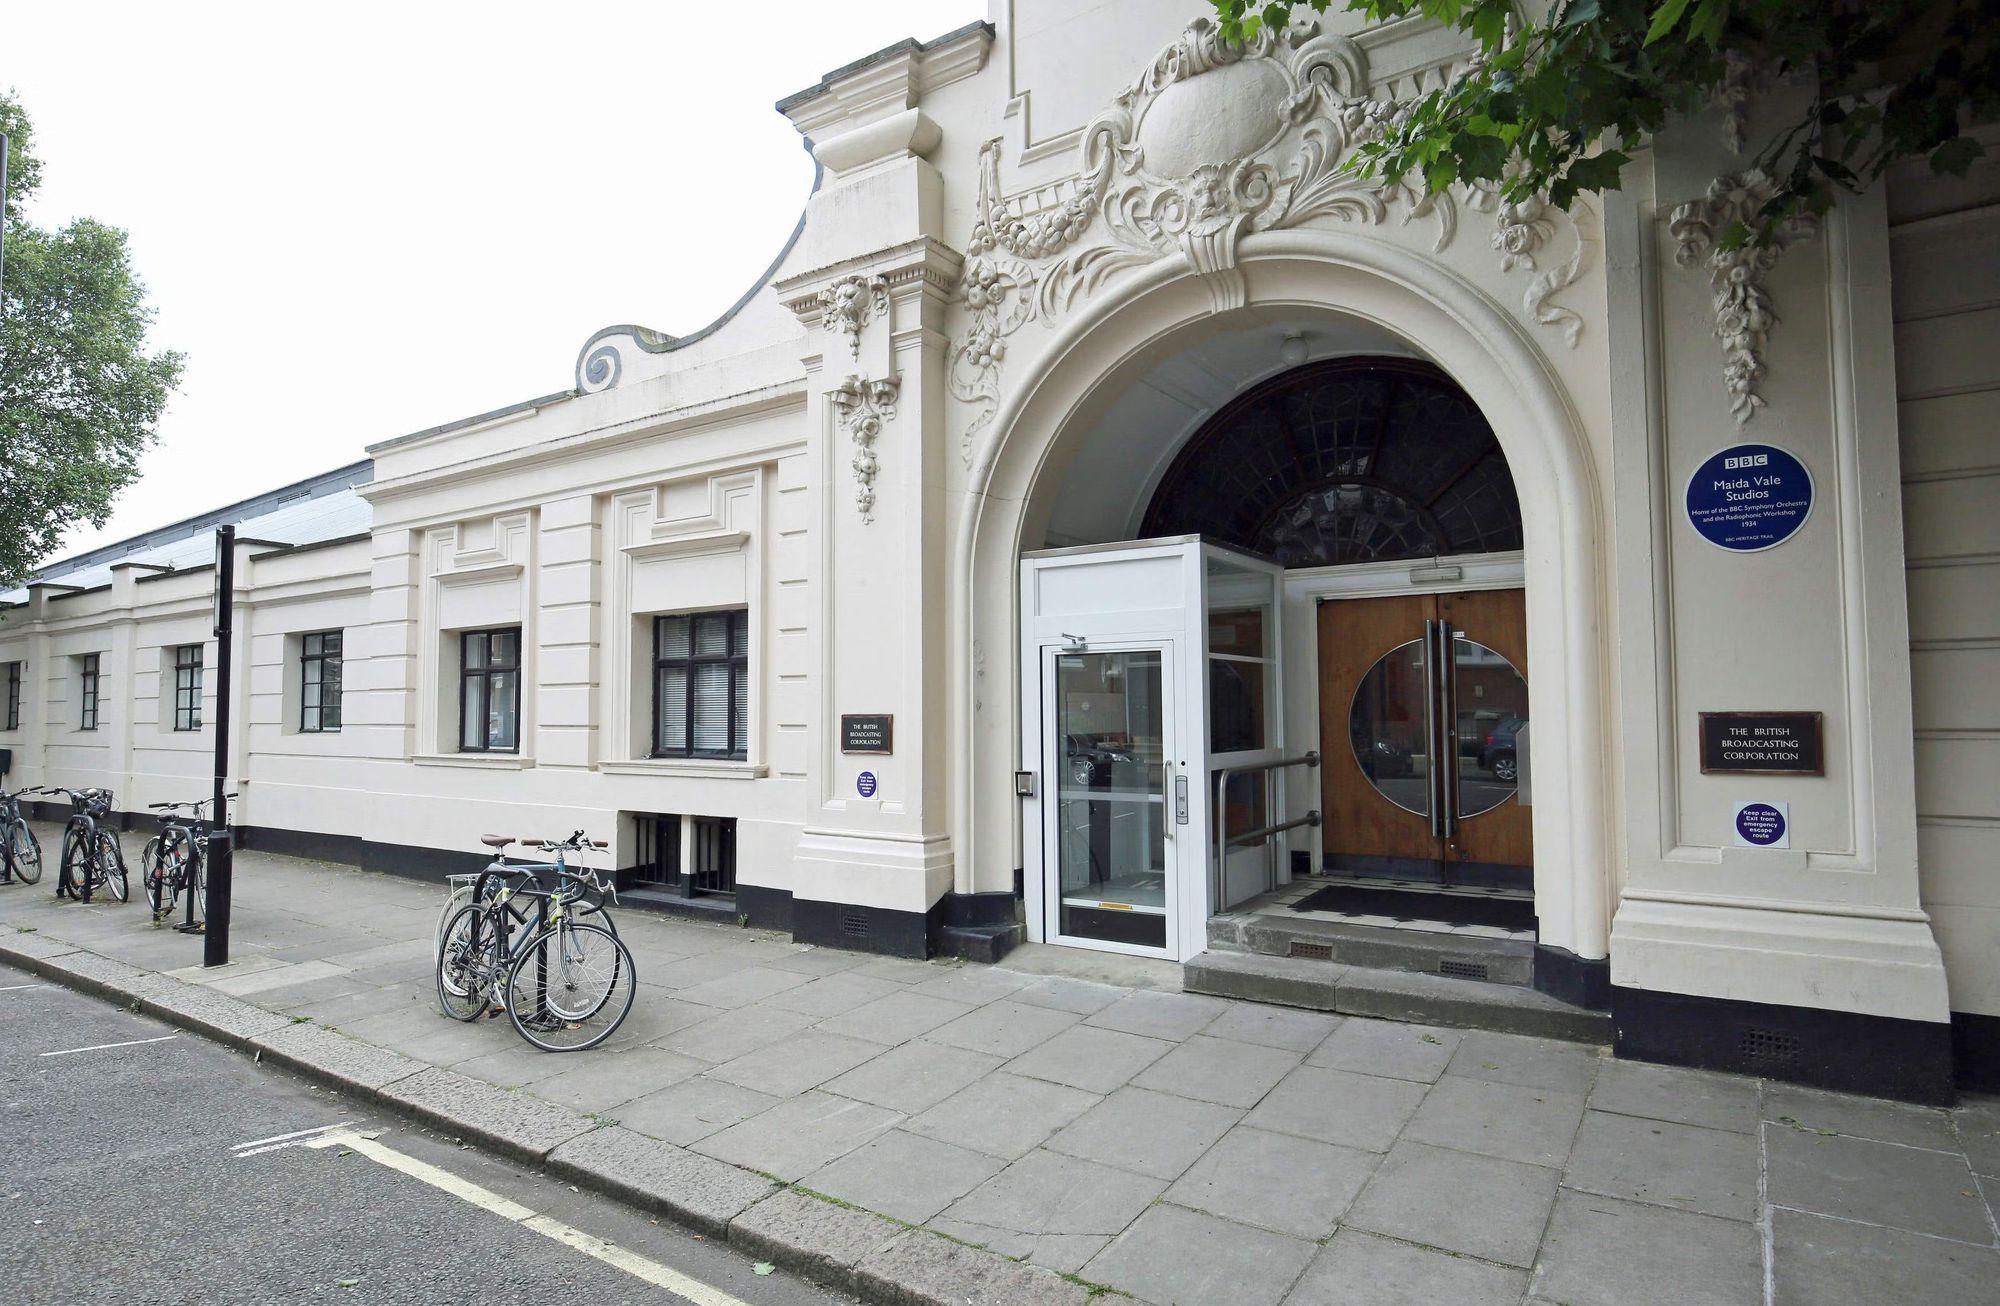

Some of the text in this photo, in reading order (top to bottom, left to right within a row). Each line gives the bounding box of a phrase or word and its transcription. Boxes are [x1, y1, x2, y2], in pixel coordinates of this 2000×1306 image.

[1725, 454, 1768, 469] BBC
[1714, 475, 1781, 491] Maida Vale
[1726, 490, 1769, 501] Studios
[1745, 503, 1774, 512] Symphony
[1776, 500, 1807, 508] Orchestra
[1726, 512, 1762, 520] Radiophonic
[1763, 509, 1796, 517] Workshop
[1729, 727, 1790, 736] THE BRITISH
[1721, 740, 1799, 748] BROADCASTING
[1723, 752, 1799, 760] CORPORATION
